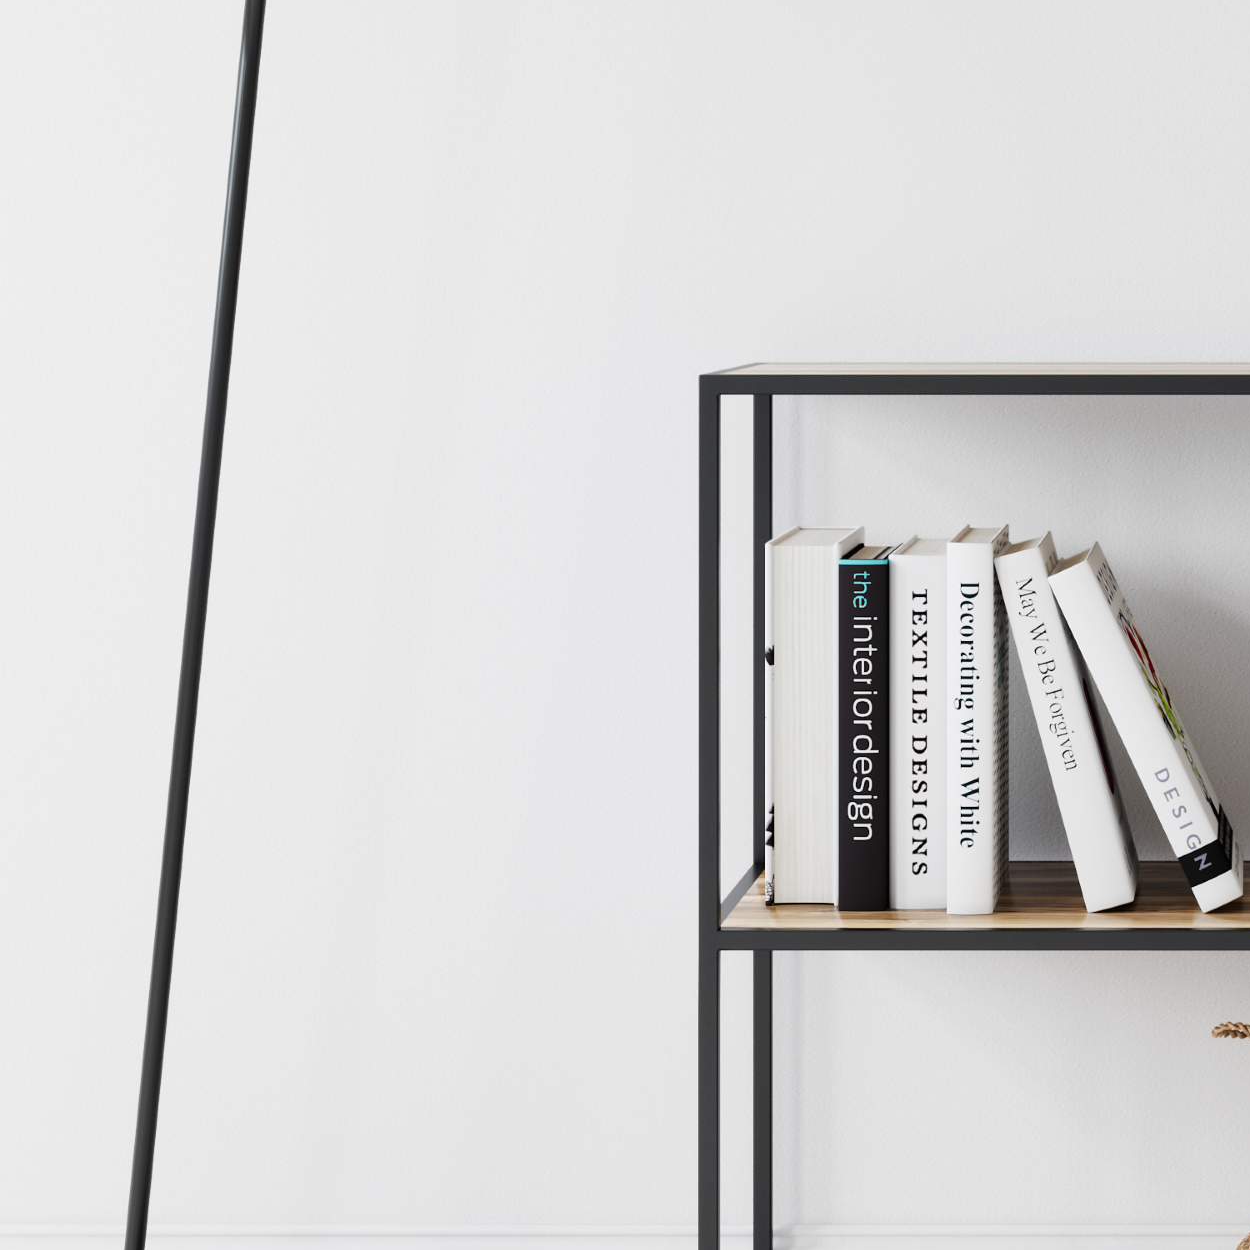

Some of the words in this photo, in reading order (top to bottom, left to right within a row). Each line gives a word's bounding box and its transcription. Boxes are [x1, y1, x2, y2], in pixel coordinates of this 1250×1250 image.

[852, 570, 872, 609] the
[1014, 577, 1038, 619] May
[911, 588, 928, 724] TEXTILE
[954, 582, 981, 711] Decorating
[1029, 622, 1050, 655] We
[1037, 658, 1057, 685] Be
[960, 718, 980, 769] with
[1045, 687, 1078, 772] Forgiven
[911, 735, 928, 876] DESIGNS
[959, 776, 981, 849] White
[1154, 767, 1213, 871] DESIGN
